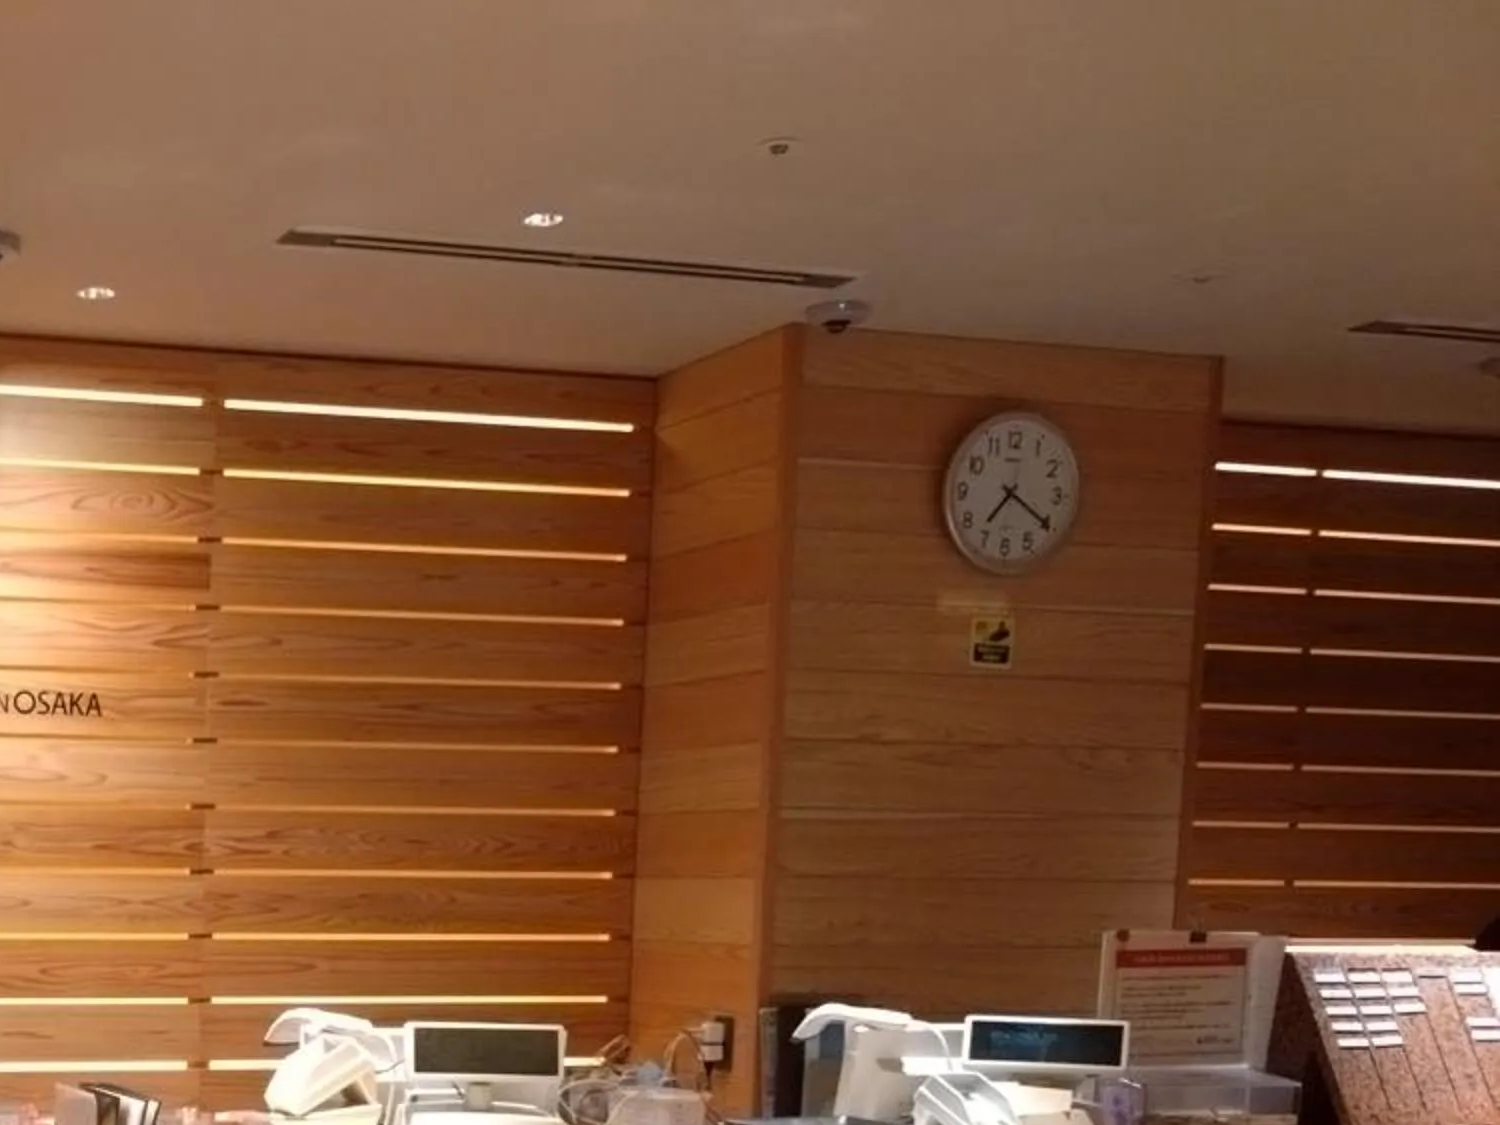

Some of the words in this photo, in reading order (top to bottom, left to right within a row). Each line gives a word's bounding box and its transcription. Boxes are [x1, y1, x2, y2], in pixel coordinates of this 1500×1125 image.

[988, 436, 999, 456] 11
[1008, 431, 1022, 449] 12
[969, 456, 984, 475] 10
[1046, 459, 1059, 478] 2
[957, 482, 969, 500] 9
[1052, 486, 1062, 505] 3
[963, 511, 973, 528] 8
[980, 529, 990, 548] 7
[999, 538, 1010, 556] 6
[1022, 531, 1033, 550] 5
[13, 689, 103, 717] OSAKA
